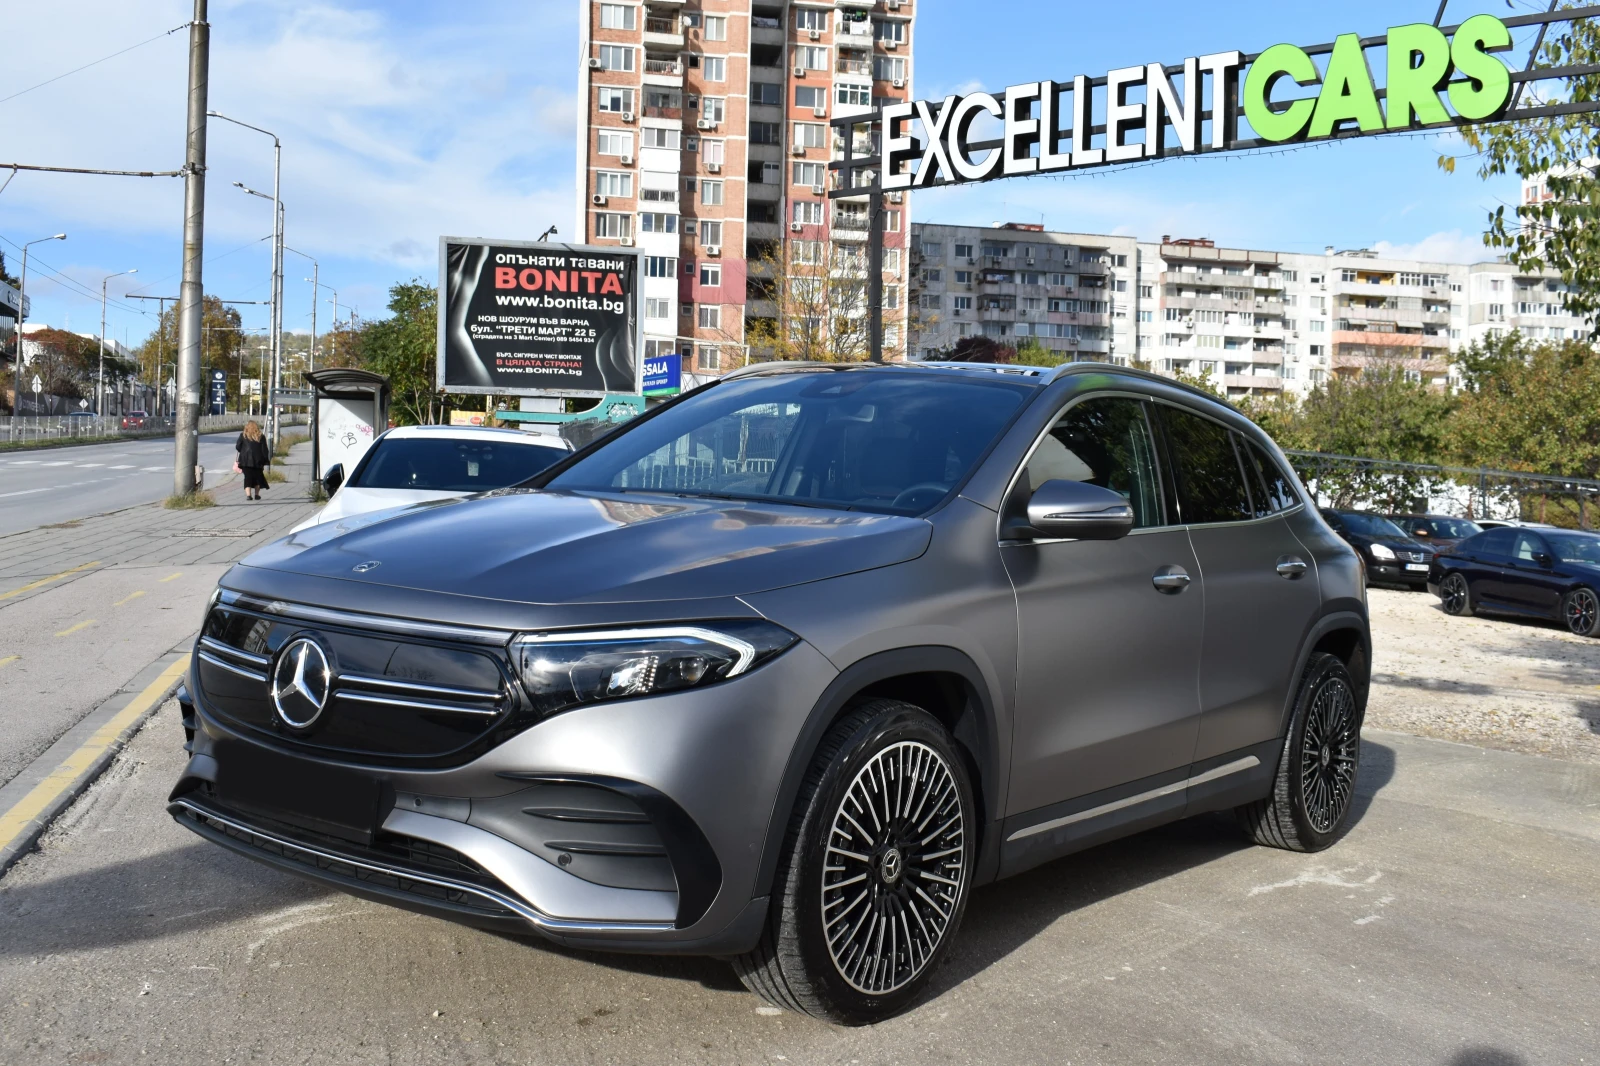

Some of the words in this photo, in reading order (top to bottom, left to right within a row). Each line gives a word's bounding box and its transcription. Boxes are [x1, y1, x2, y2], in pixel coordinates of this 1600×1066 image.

[881, 51, 1241, 190] EXCELLENT
[1243, 14, 1513, 142] CARS
[495, 253, 565, 267] опънати
[570, 257, 624, 271] тавани
[495, 266, 624, 295] BONITA
[495, 295, 624, 314] www.bonita.bg
[499, 316, 537, 324] ШОУРУМ
[539, 317, 558, 325] ВЪВ
[560, 318, 589, 326] ВАРНА
[470, 325, 493, 334] бул.
[574, 328, 586, 337] 22
[589, 329, 596, 337] Б
[505, 359, 542, 367] ЦЯЛАТА
[544, 360, 582, 368] СТРАНА!
[496, 367, 582, 376] www.BONITA.bg
